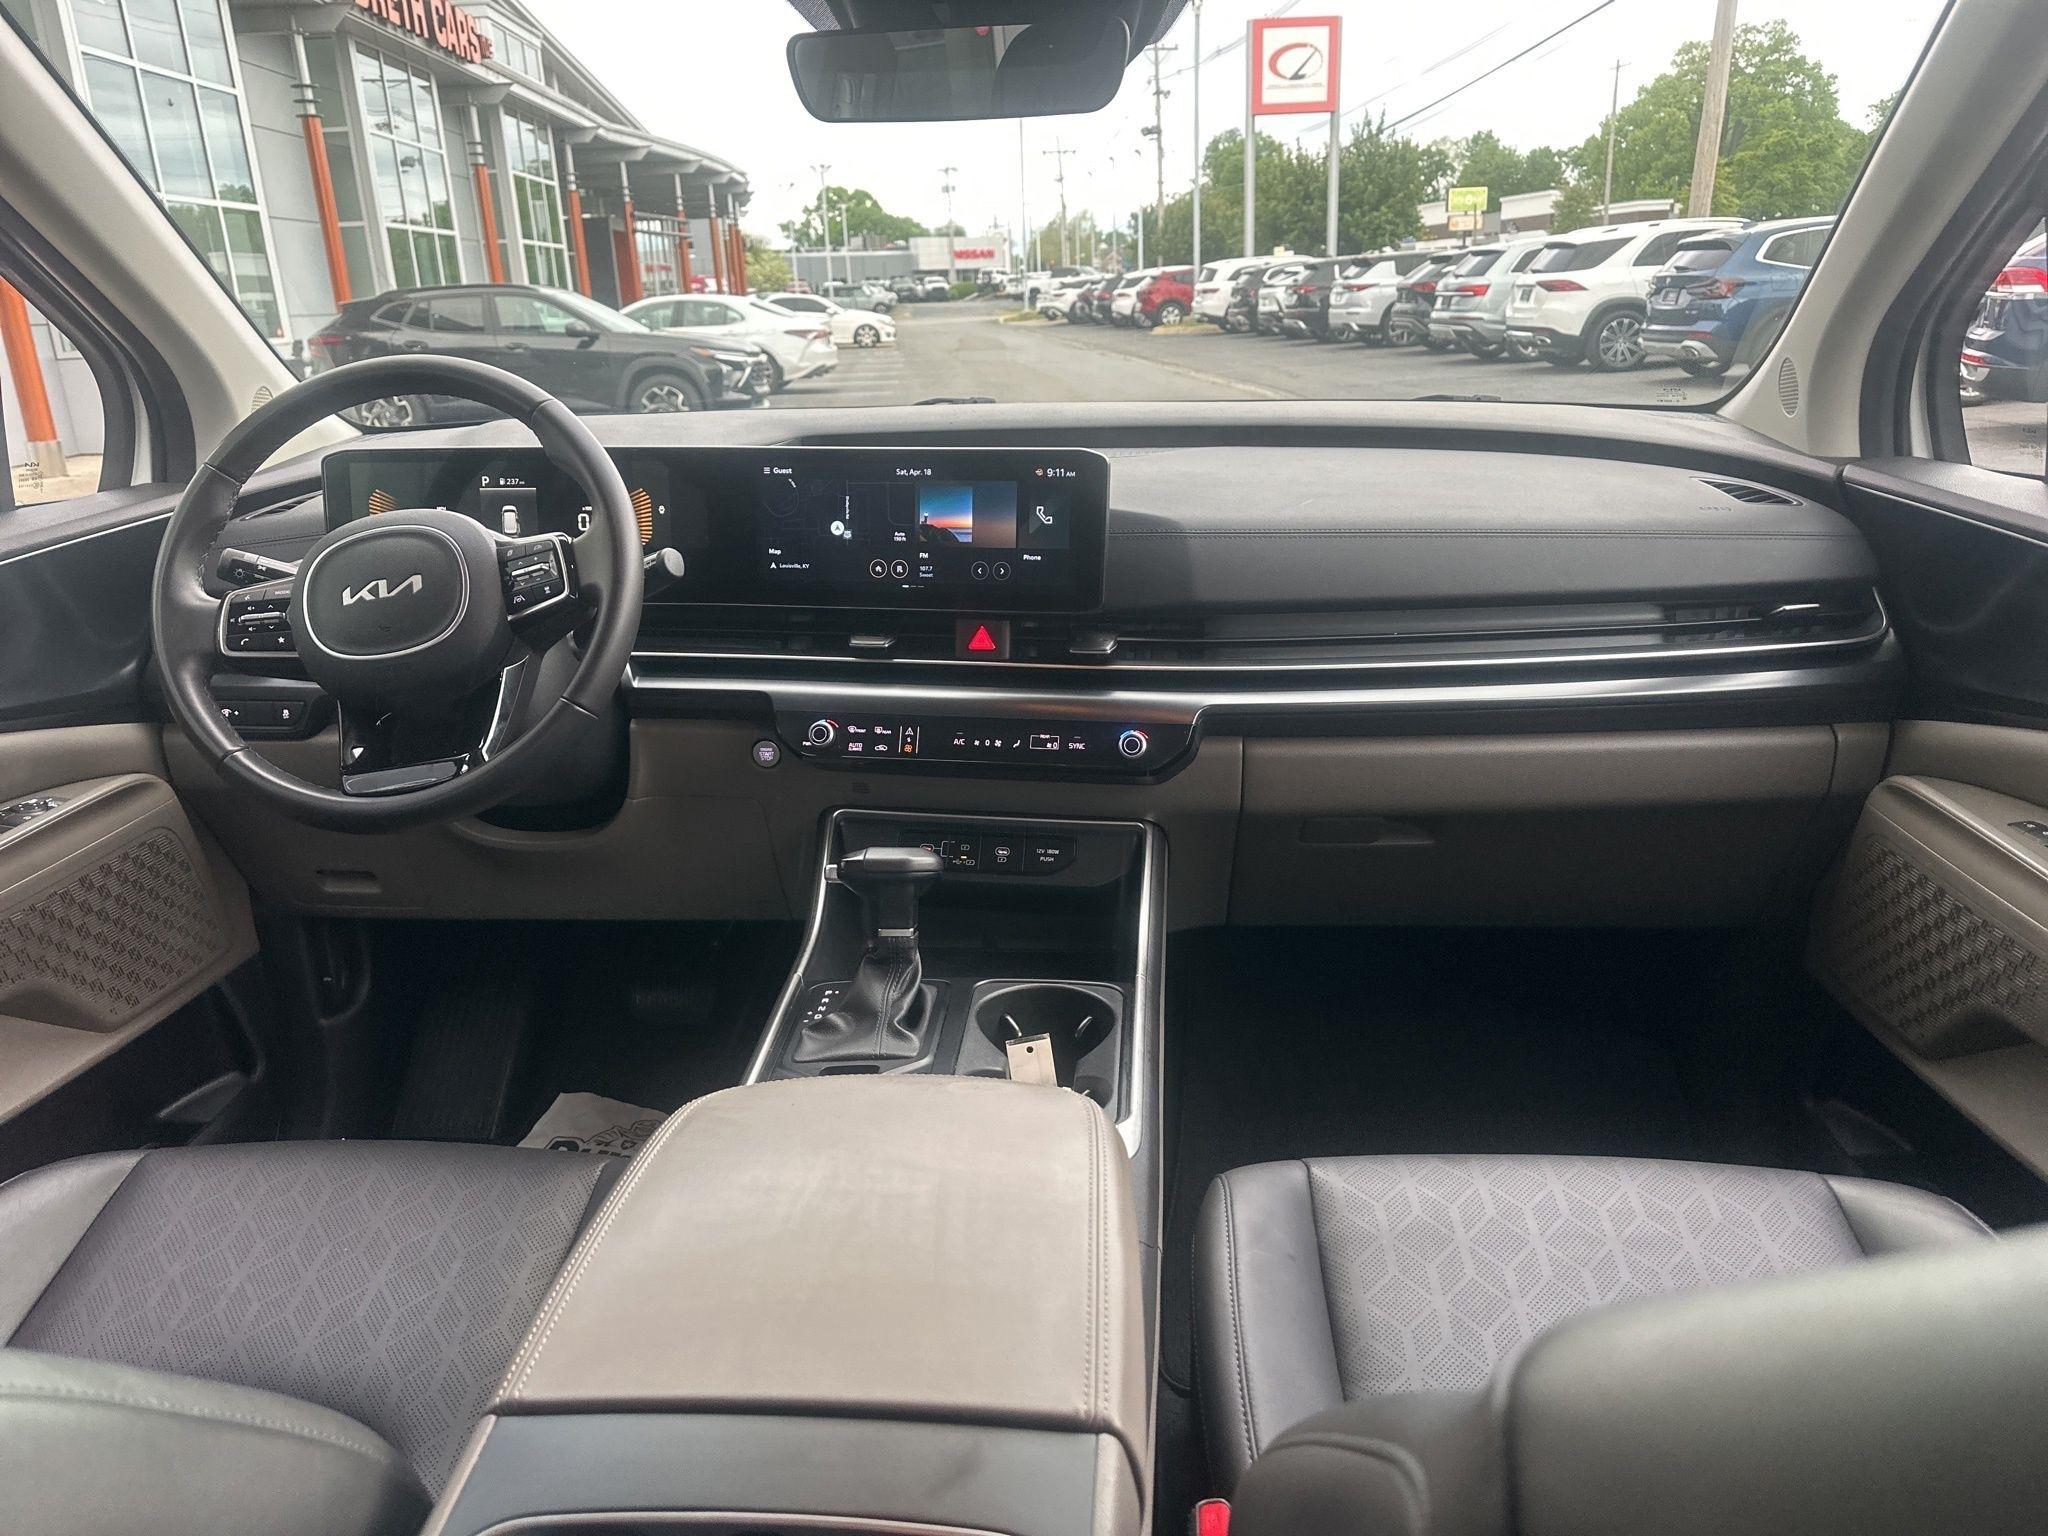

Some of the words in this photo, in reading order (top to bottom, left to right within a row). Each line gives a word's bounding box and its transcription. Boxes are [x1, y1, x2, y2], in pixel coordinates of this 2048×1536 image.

[355, 0, 429, 39] ETH
[431, 0, 482, 65] CARS
[895, 468, 909, 476] Sat,
[909, 468, 923, 476] Apr.
[923, 468, 932, 476] 18
[1047, 468, 1065, 477] 9:11
[481, 475, 490, 487] P
[577, 513, 590, 531] 0
[1068, 742, 1086, 750] SYNC
